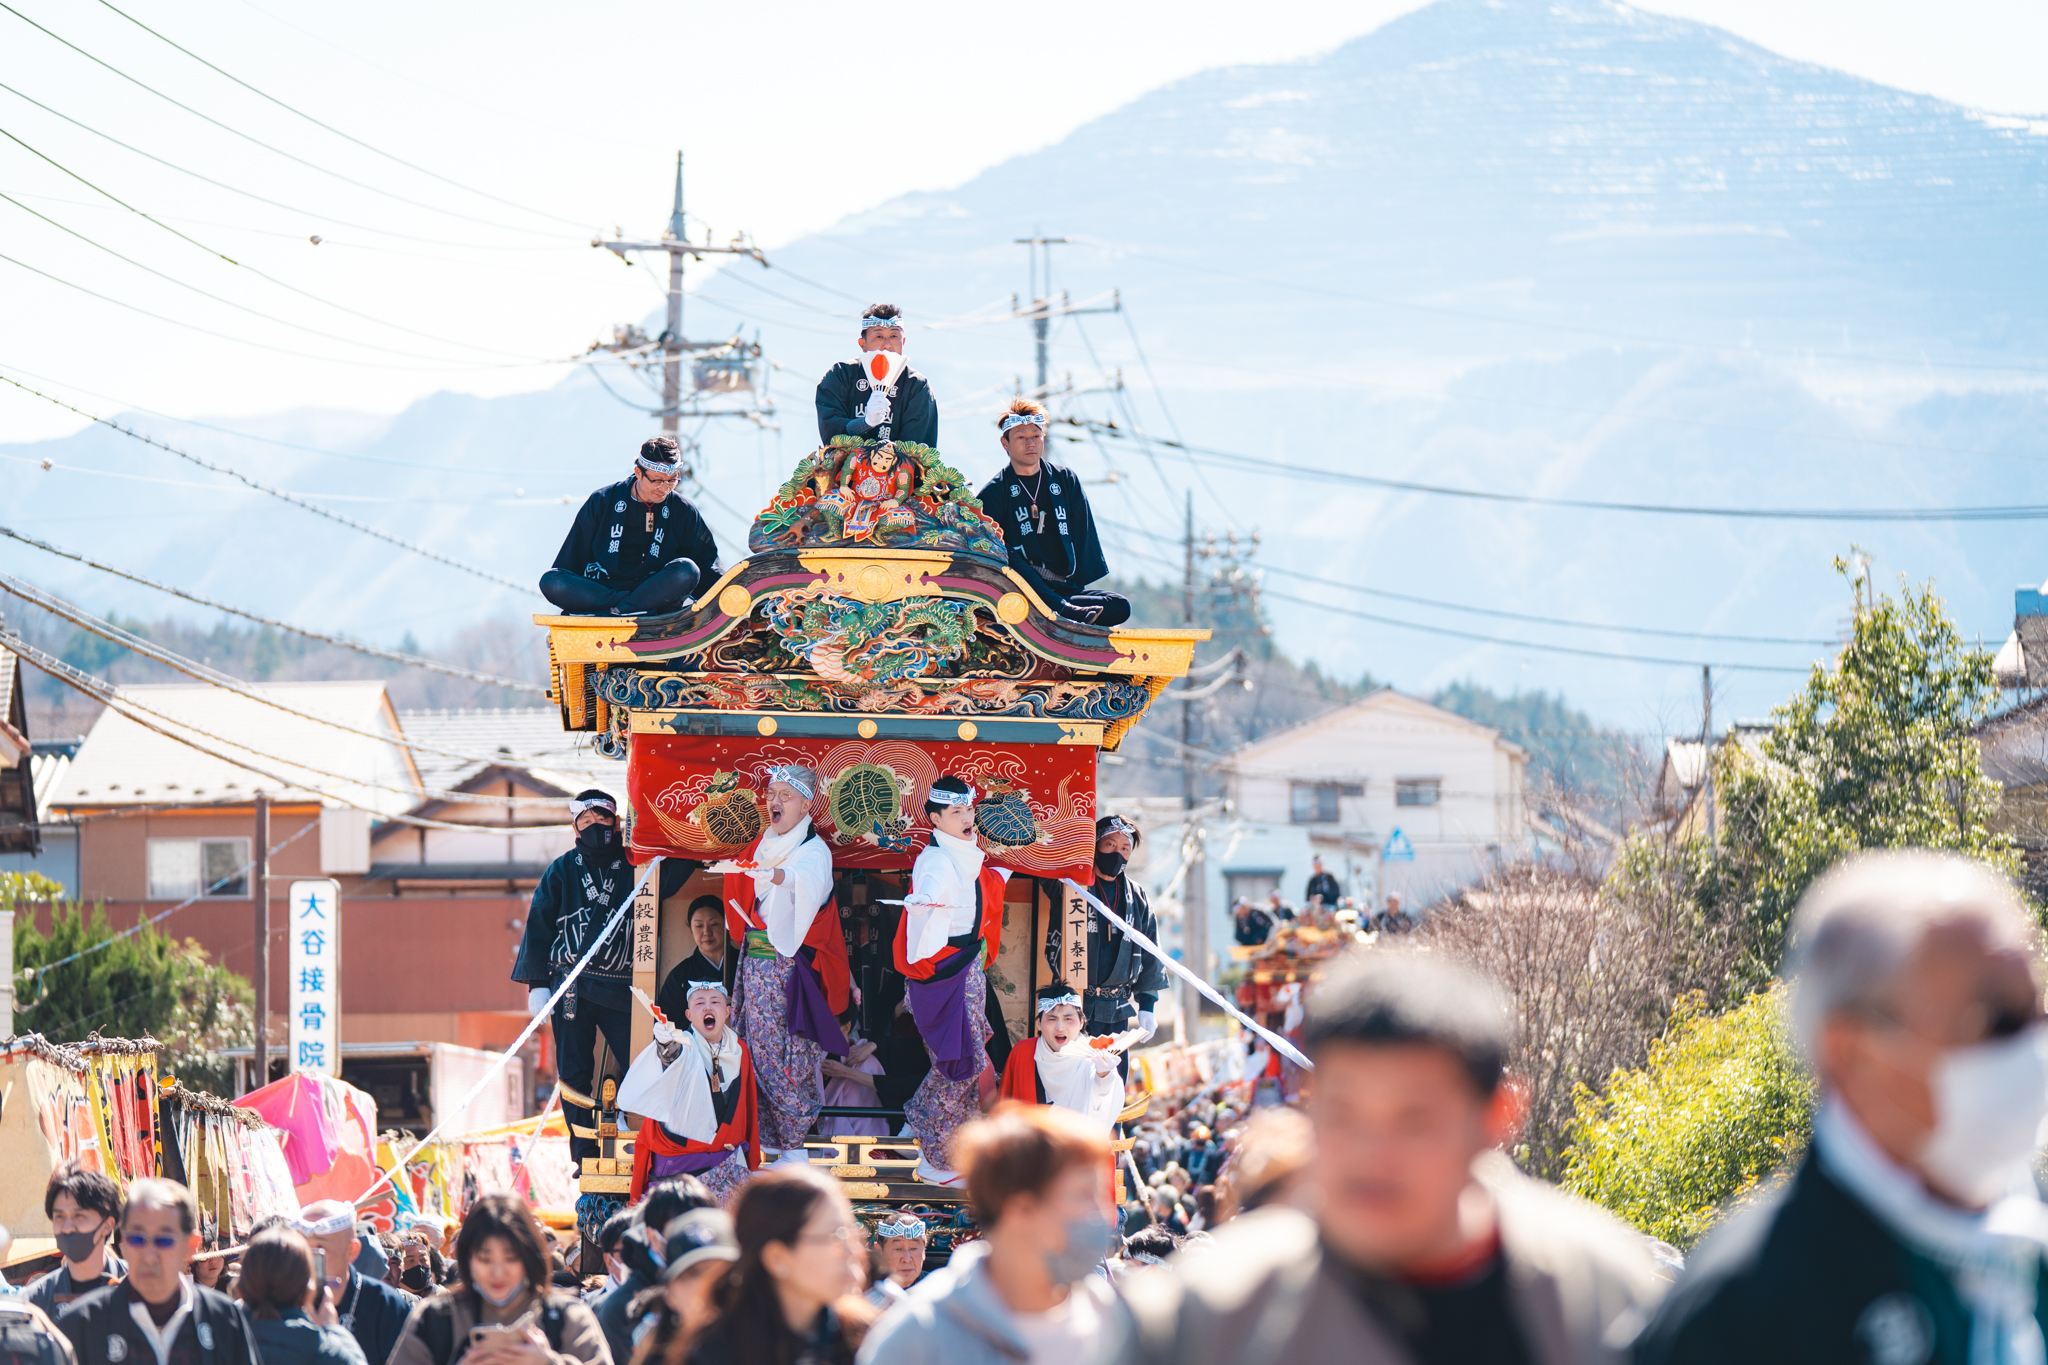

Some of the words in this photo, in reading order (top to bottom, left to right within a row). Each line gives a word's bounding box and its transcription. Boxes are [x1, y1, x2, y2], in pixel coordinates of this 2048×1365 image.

[1015, 506, 1034, 536] 山組
[1055, 505, 1069, 536] 山組
[608, 523, 624, 554] 山組
[649, 527, 665, 558] 山組
[581, 872, 600, 902] 山組
[597, 878, 616, 907] 山組
[635, 881, 655, 963] 五穀豊穣
[1068, 898, 1086, 978] 天下泰平
[299, 891, 326, 1068] 大谷接骨院
